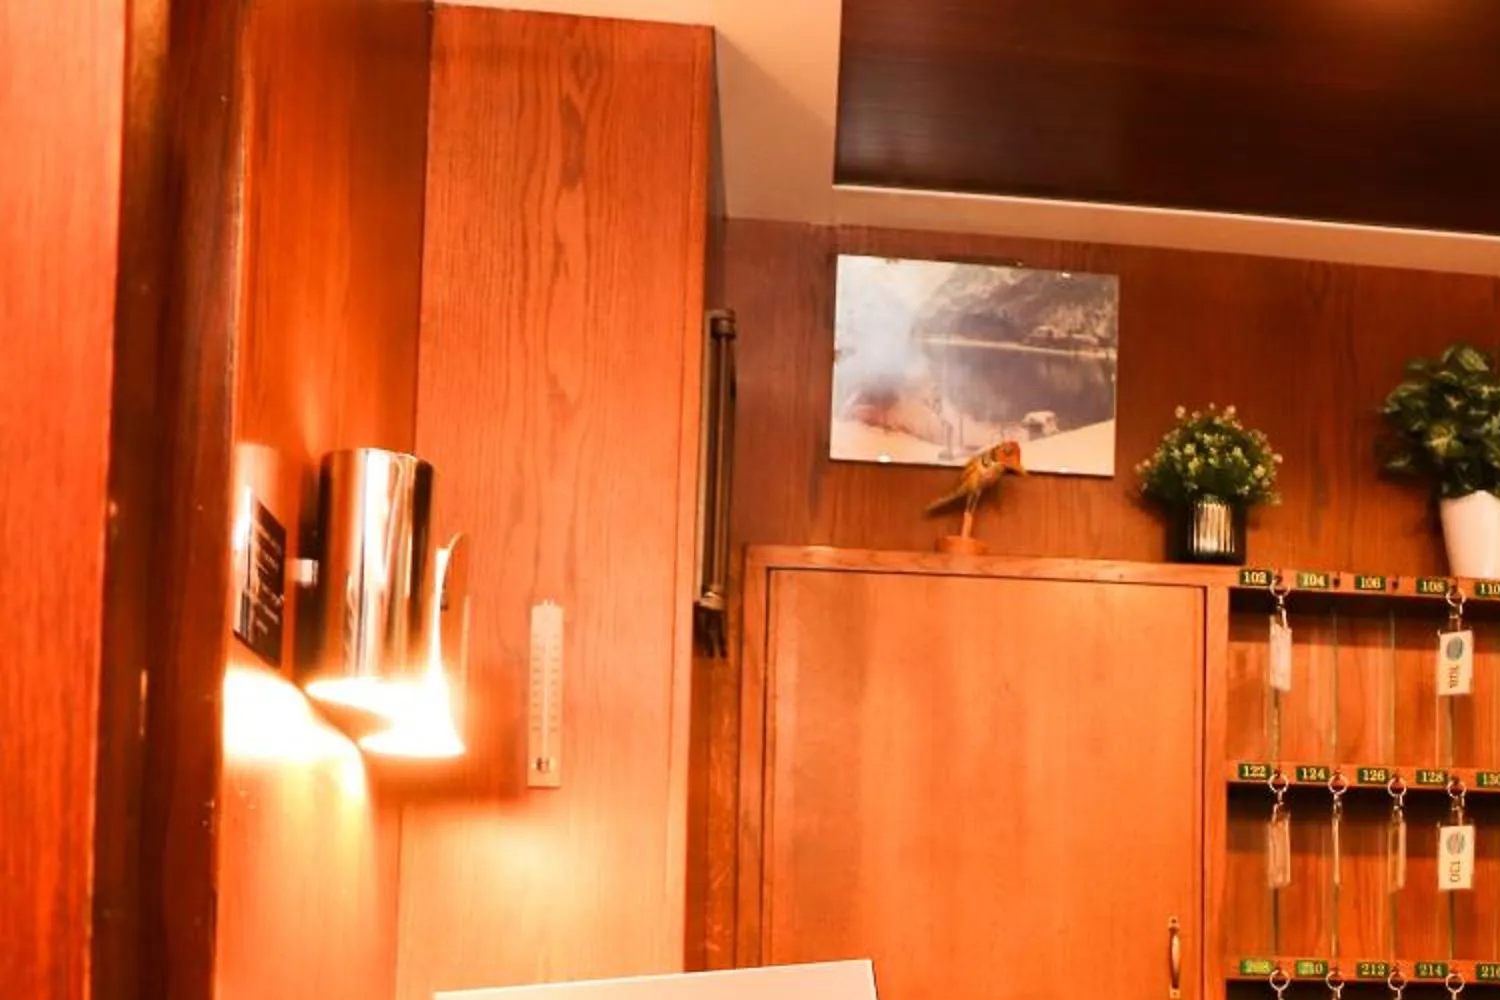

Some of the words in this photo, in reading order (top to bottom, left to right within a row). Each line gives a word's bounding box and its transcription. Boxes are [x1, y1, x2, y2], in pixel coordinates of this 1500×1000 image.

[1243, 571, 1266, 583] 102
[1300, 574, 1325, 586] 104
[1360, 577, 1381, 589] 106
[1421, 580, 1444, 593] 108
[1480, 583, 1500, 596] 110
[1243, 765, 1266, 778] 122
[1302, 768, 1325, 781] 124
[1362, 769, 1386, 782] 126
[1421, 772, 1444, 784] 128
[1449, 860, 1461, 883] 130
[1362, 963, 1385, 976] 212
[1420, 964, 1443, 976] 214
